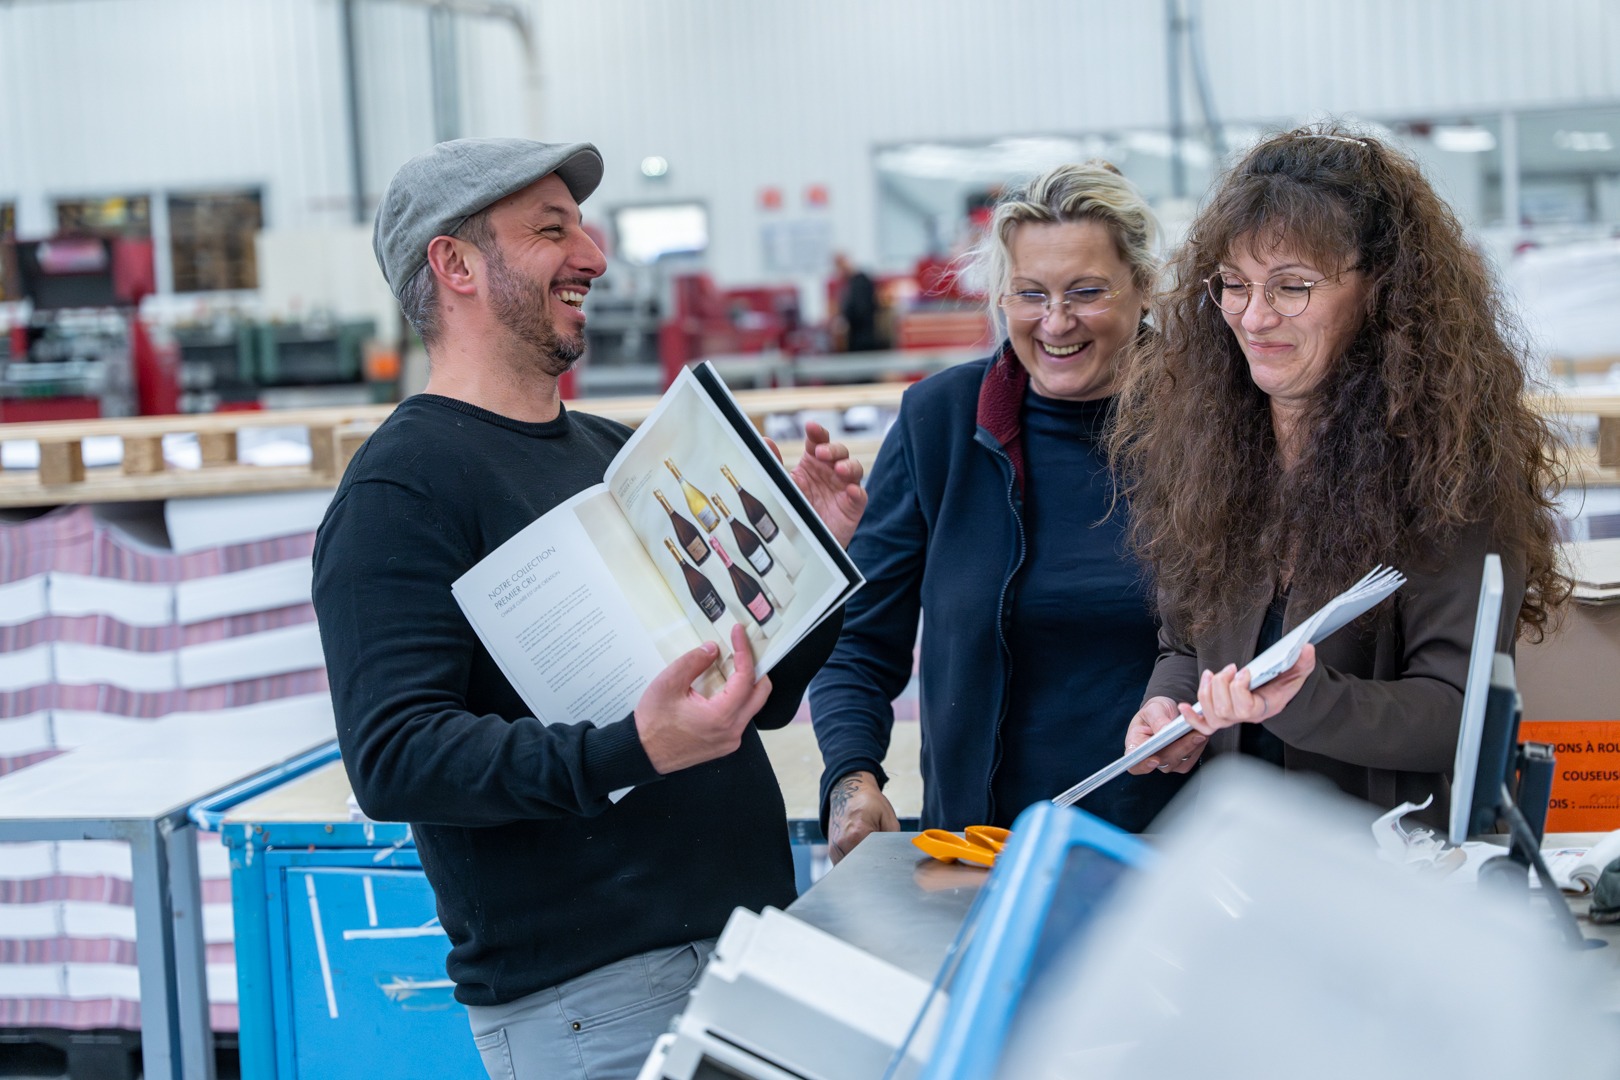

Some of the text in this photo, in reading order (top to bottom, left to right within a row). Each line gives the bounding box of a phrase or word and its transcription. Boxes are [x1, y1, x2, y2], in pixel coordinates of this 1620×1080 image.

[488, 546, 556, 600] NOTRE COLLECTION
[494, 574, 537, 610] PREMIER CRU
[1586, 740, 1594, 753] À
[1562, 770, 1620, 781] COUSEUS
